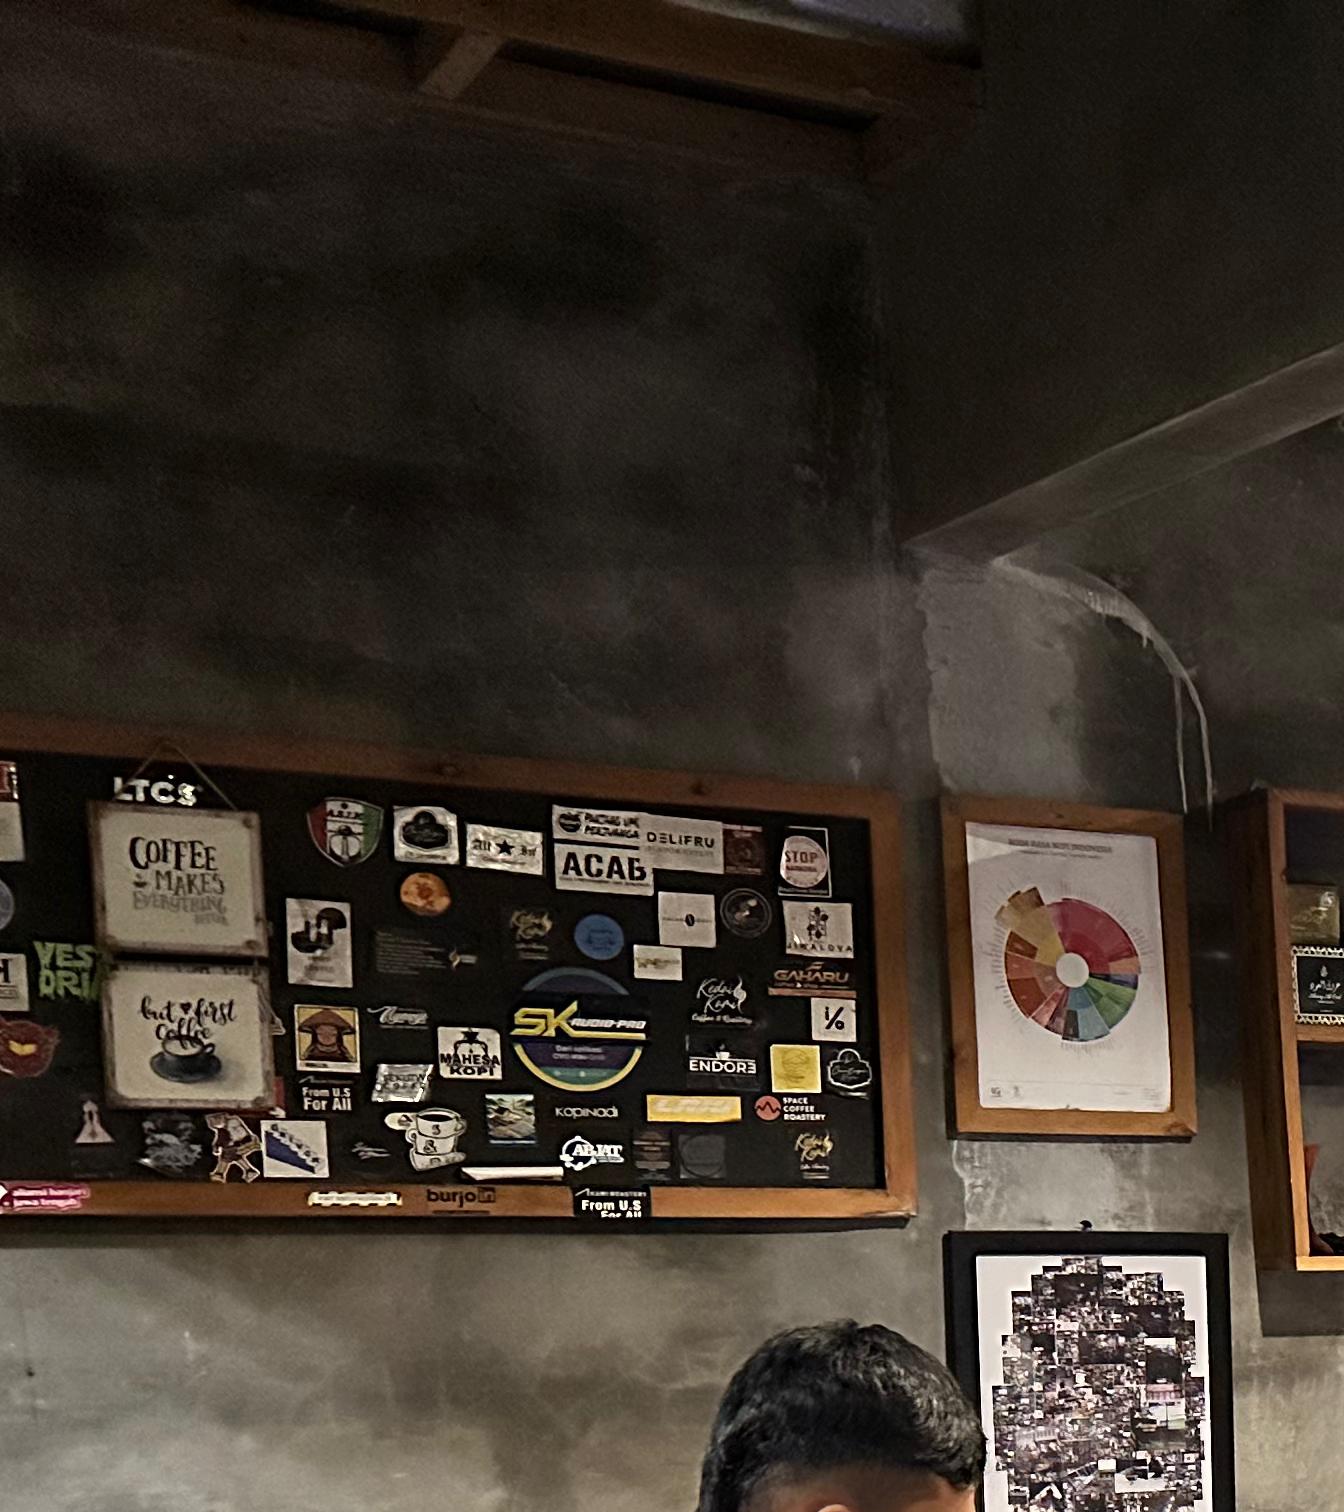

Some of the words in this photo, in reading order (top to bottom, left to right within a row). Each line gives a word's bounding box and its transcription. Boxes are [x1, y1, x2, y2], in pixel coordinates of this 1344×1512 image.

[129, 837, 218, 871] COFFEE
[784, 850, 818, 864] STOP
[155, 870, 225, 896] MAKES
[33, 941, 97, 967] YES
[39, 967, 98, 999] DRI
[774, 969, 849, 983] GAHARU
[140, 995, 176, 1024] but
[195, 997, 237, 1026] first
[440, 1053, 500, 1066] MAHESA
[450, 1065, 495, 1077] KOPI
[302, 1087, 330, 1098] From
[304, 1098, 327, 1110] For
[332, 1097, 352, 1111] All
[782, 1097, 808, 1105] SPACE
[783, 1105, 815, 1113] COFFEE
[783, 1113, 826, 1121] ROASTERY
[581, 1199, 615, 1212] From
[618, 1199, 642, 1211] U.S
